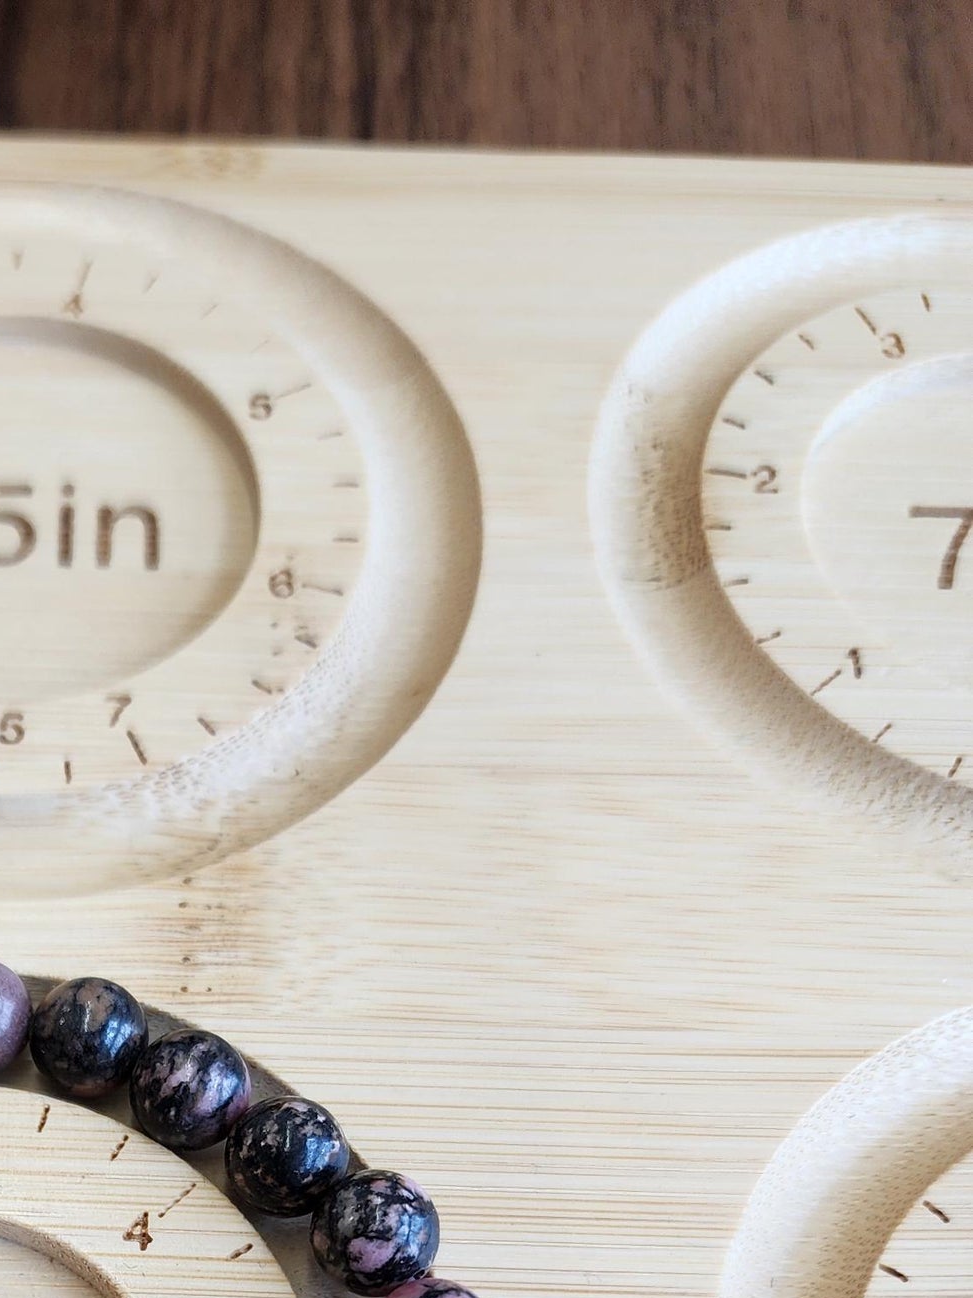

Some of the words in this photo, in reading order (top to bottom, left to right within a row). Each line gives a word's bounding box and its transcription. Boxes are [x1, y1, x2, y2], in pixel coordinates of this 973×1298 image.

[63, 292, 84, 317] 4
[881, 331, 907, 360] 3
[249, 393, 274, 421] 5
[750, 464, 779, 494] 2
[267, 569, 296, 600] 6
[847, 647, 863, 680] 1
[105, 694, 132, 729] 7
[122, 1210, 154, 1252] 4
